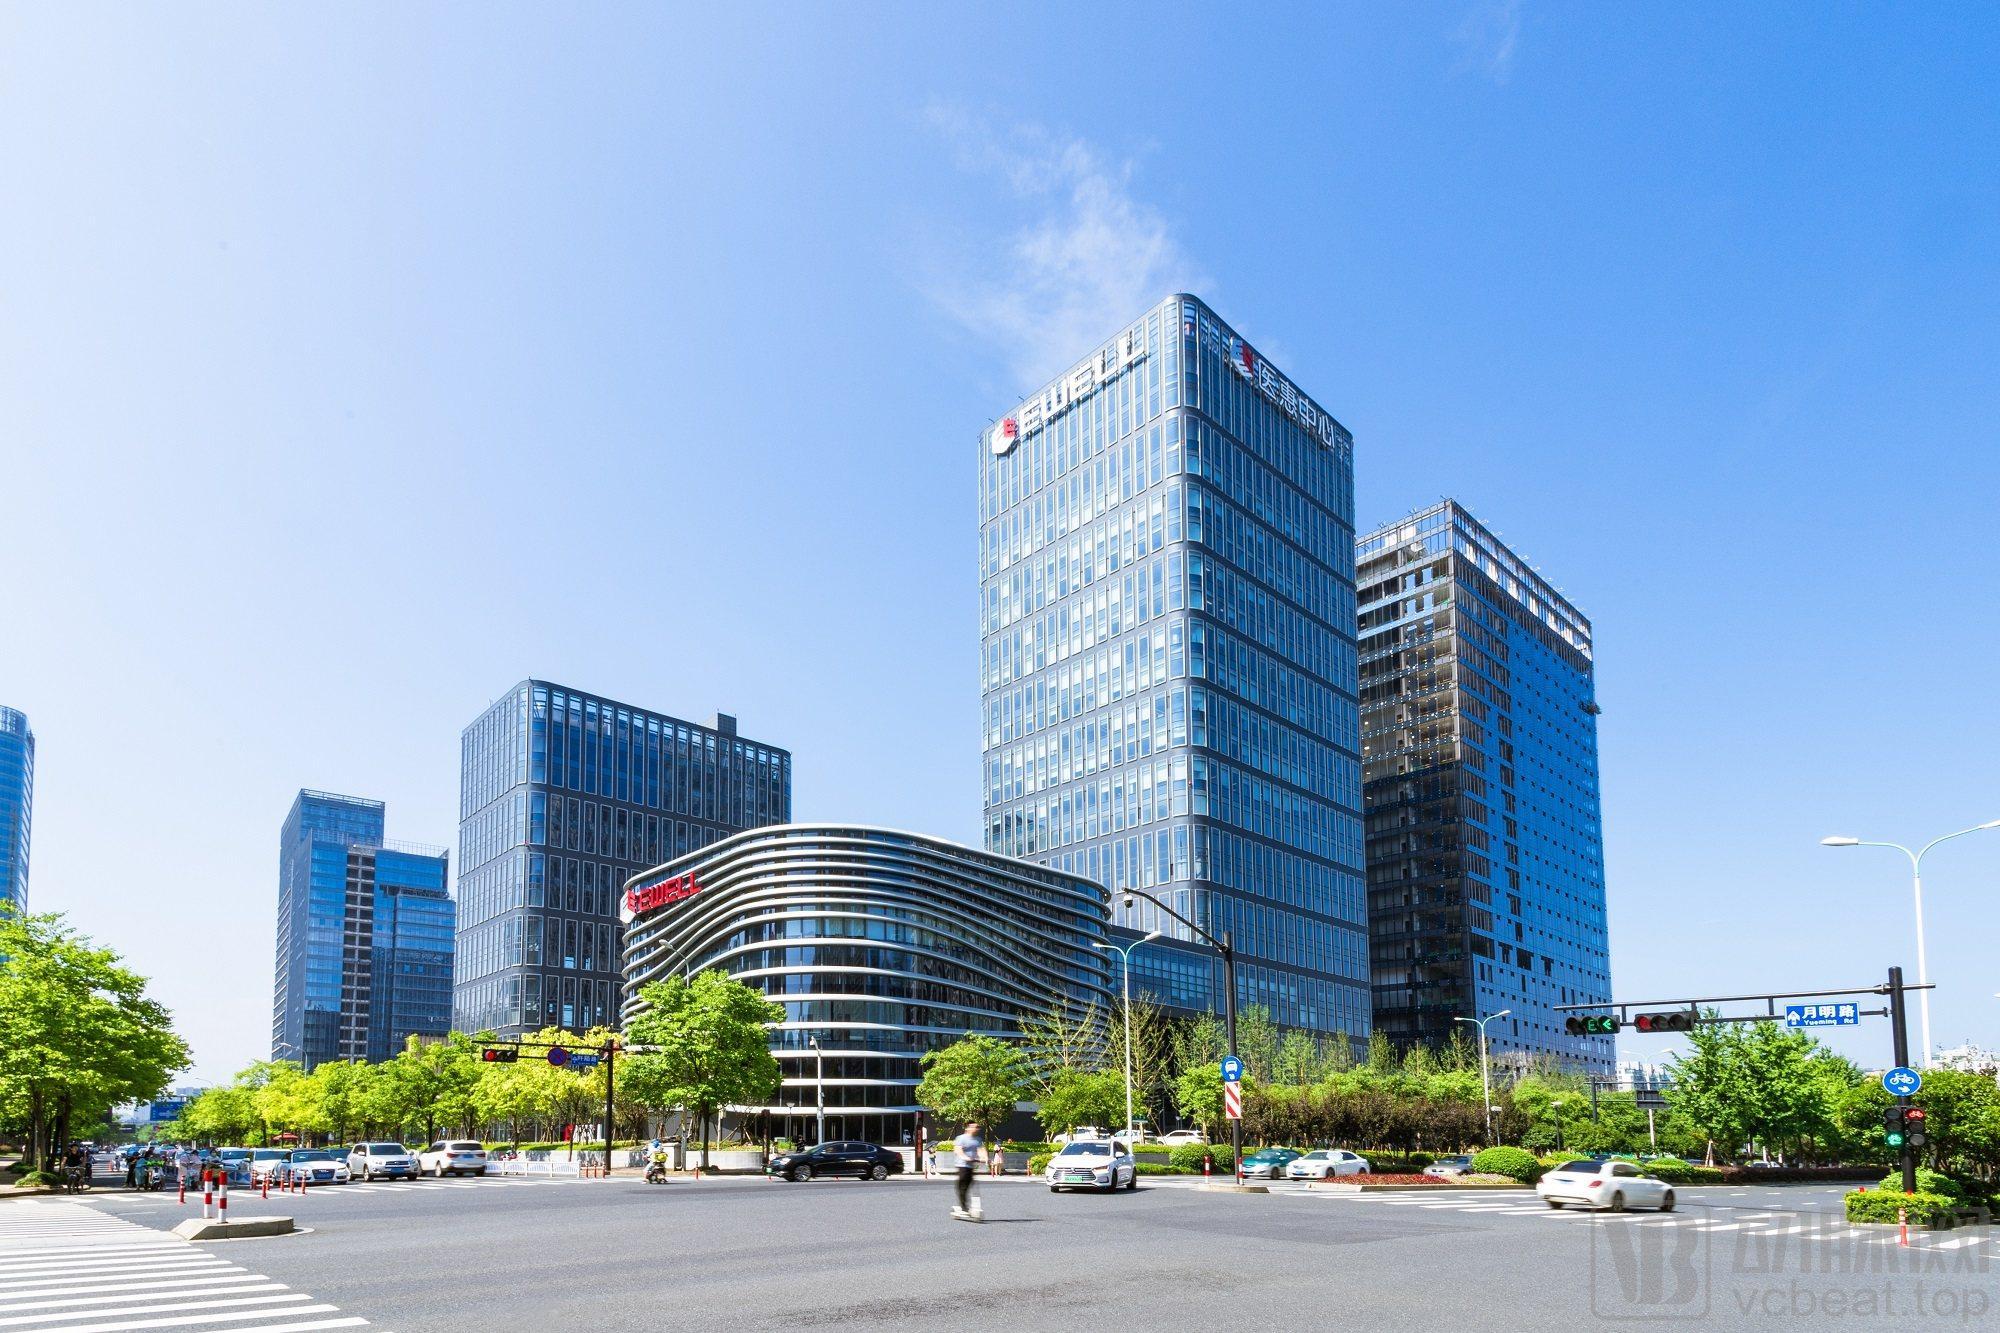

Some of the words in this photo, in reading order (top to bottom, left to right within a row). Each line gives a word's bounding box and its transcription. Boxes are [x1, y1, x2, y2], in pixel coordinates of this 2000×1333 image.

[1018, 334, 1145, 438] EWELL
[1258, 358, 1334, 449] 医惠中心
[637, 870, 703, 914] EWELL
[1802, 1005, 1855, 1019] 月明路
